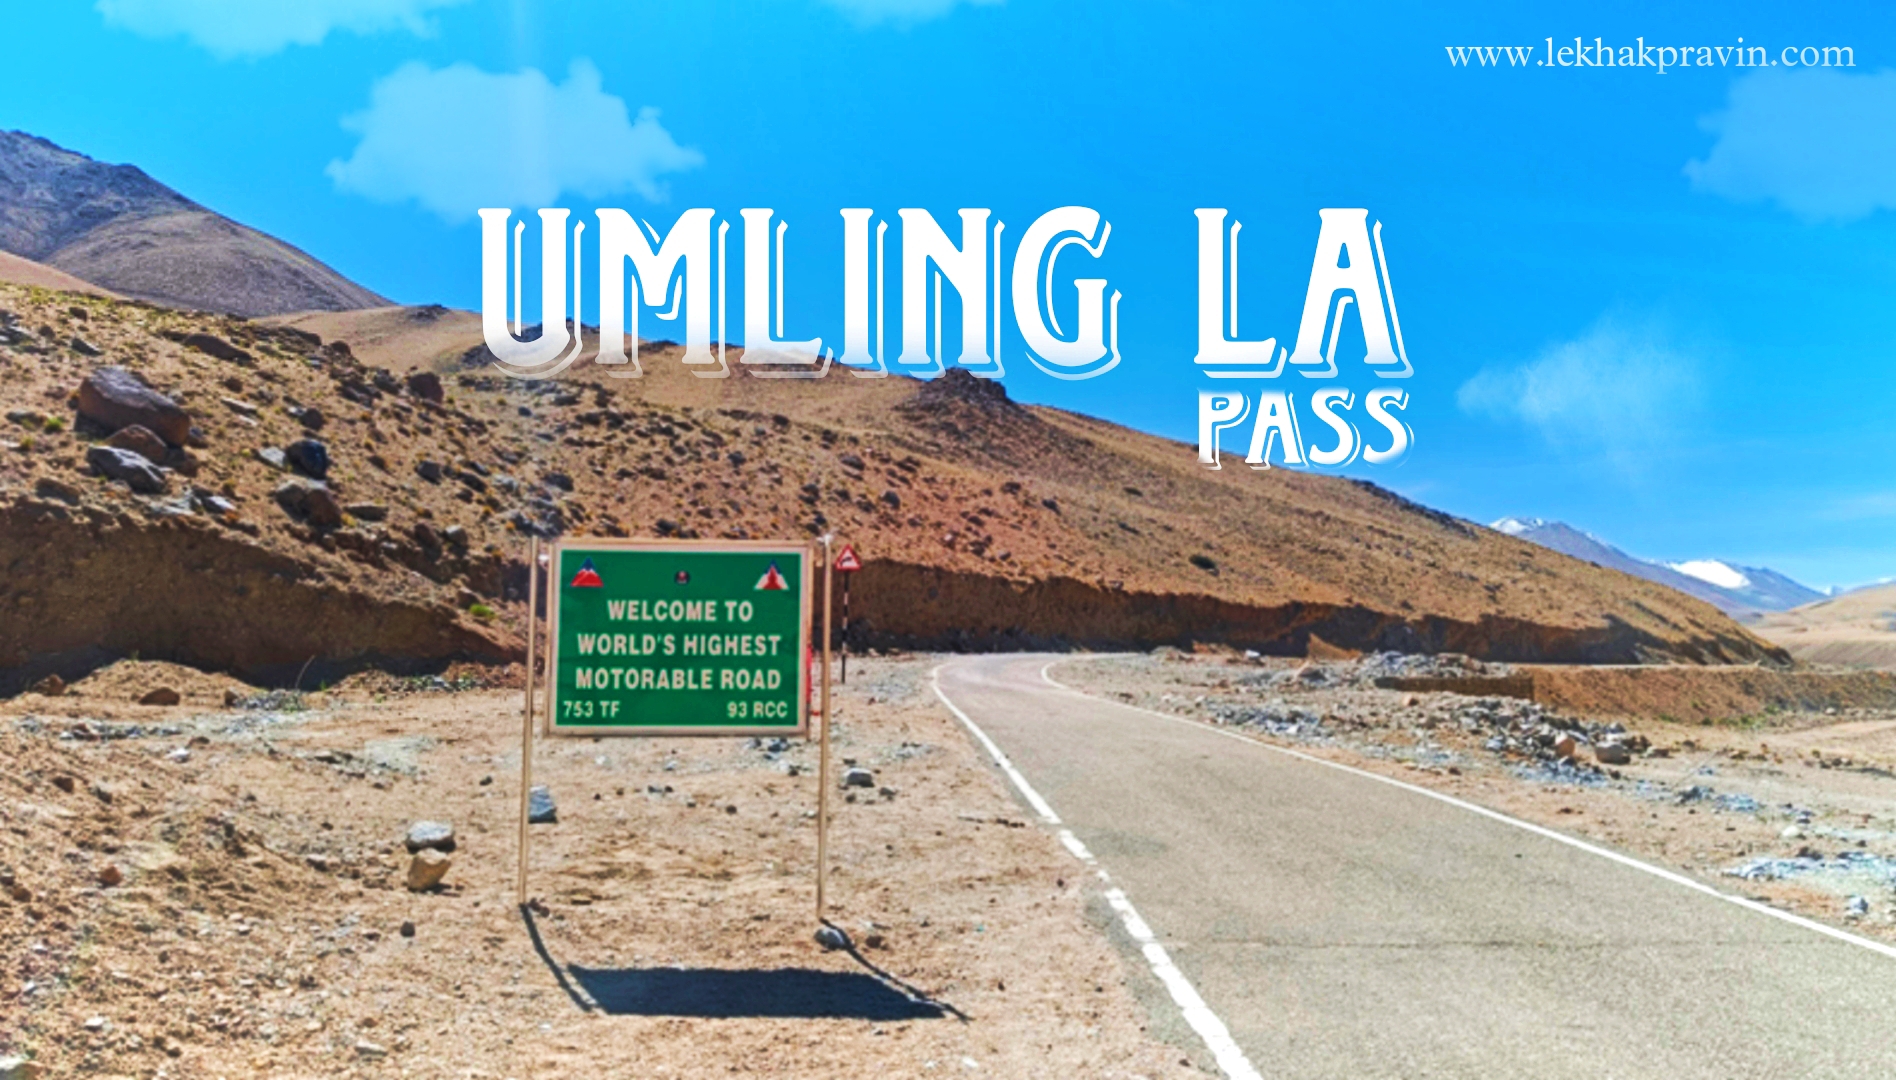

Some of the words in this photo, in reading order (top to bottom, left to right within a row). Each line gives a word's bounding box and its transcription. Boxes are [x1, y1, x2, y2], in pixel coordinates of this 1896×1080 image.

[607, 600, 717, 622] WELCOME
[725, 601, 753, 622] TO
[577, 633, 676, 655] WORLD'S
[683, 635, 782, 656] HIGHEST
[575, 668, 713, 690] MOTORABLE
[720, 669, 782, 690] ROAD
[563, 701, 594, 718] 753
[600, 701, 621, 717] TF
[727, 702, 748, 719] 93
[753, 702, 788, 719] RCC
